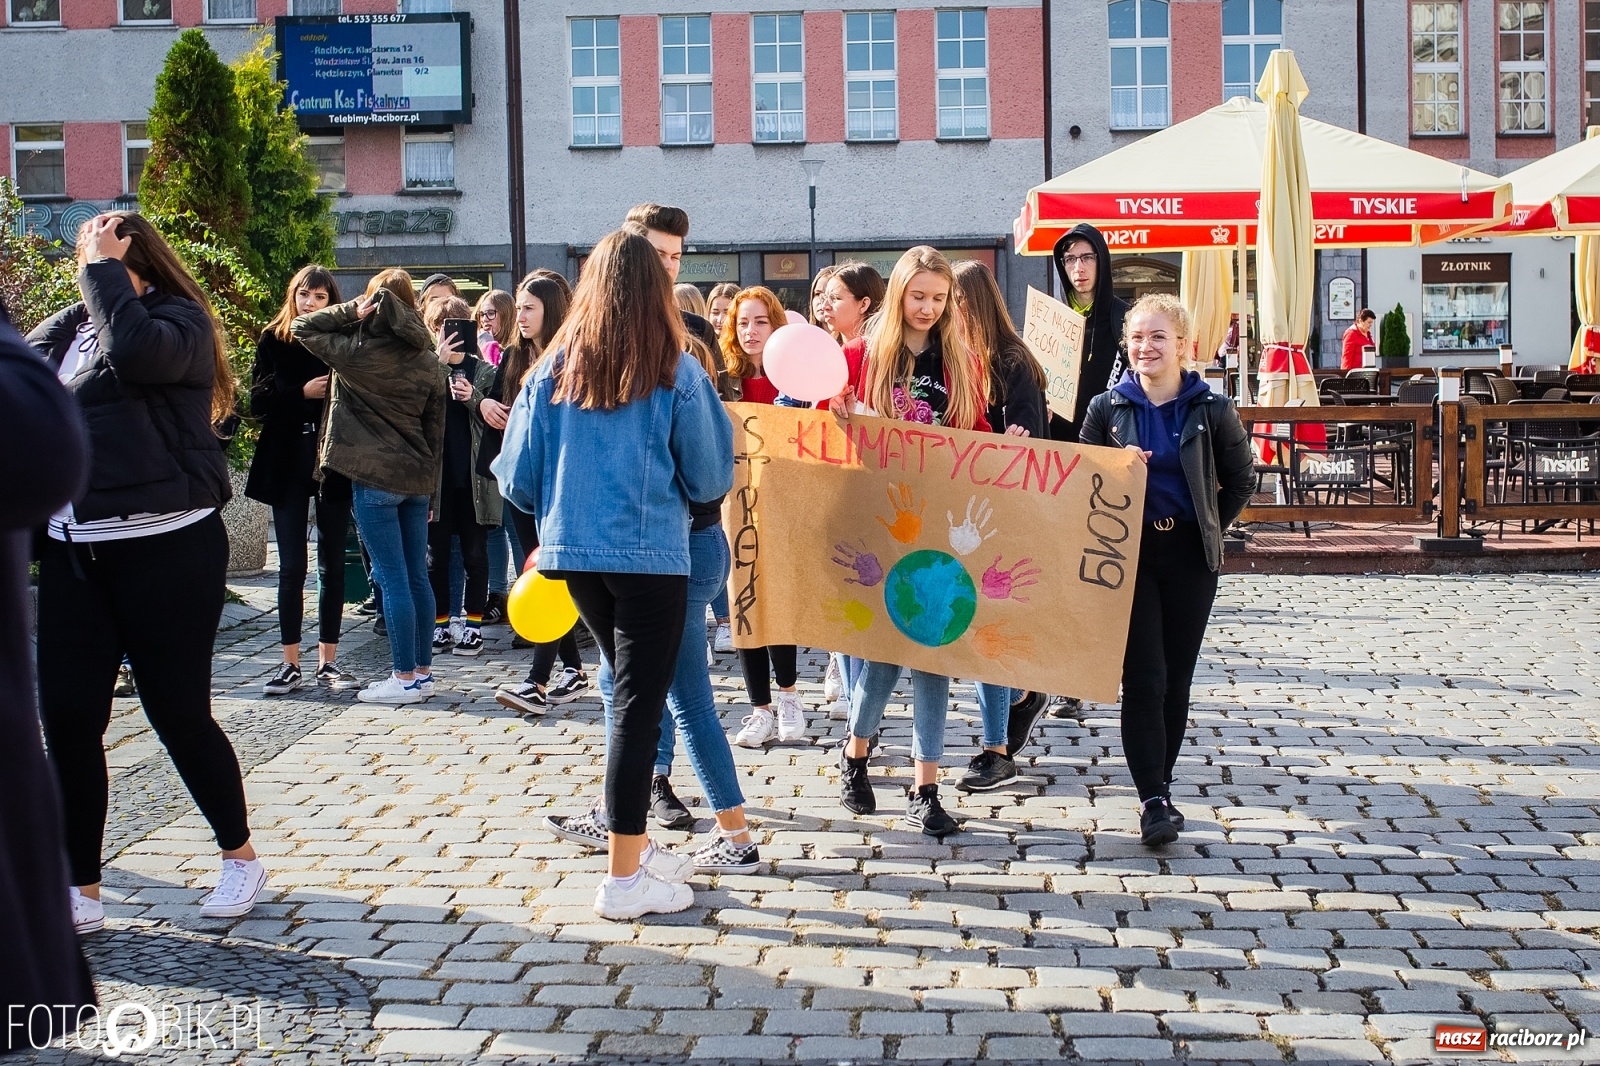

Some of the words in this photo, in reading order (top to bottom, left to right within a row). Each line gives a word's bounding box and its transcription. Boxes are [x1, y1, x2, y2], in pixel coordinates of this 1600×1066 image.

[338, 15, 352, 23] tel.
[354, 15, 370, 23] 533
[372, 15, 388, 23] 355
[390, 14, 406, 22] 677
[413, 56, 424, 64] 16
[291, 90, 332, 110] Centrum
[335, 89, 355, 109] Kas
[329, 113, 420, 124] Telebimy-Raciborz.pl
[1116, 198, 1183, 215] TYSKIE
[1350, 197, 1417, 215] TYSKIE
[1441, 261, 1491, 271] ZŁOTNIK
[1031, 297, 1050, 323] BEZ
[1052, 311, 1082, 352] NASZEJ
[1061, 342, 1073, 358] NIE
[1061, 357, 1071, 370] MA
[788, 420, 1081, 496] KLIMATYCZNY
[1306, 458, 1355, 475] TYSKIE
[1542, 456, 1590, 473] TYSKIE
[734, 415, 771, 637] STRAJK
[1079, 472, 1131, 590] 2019
